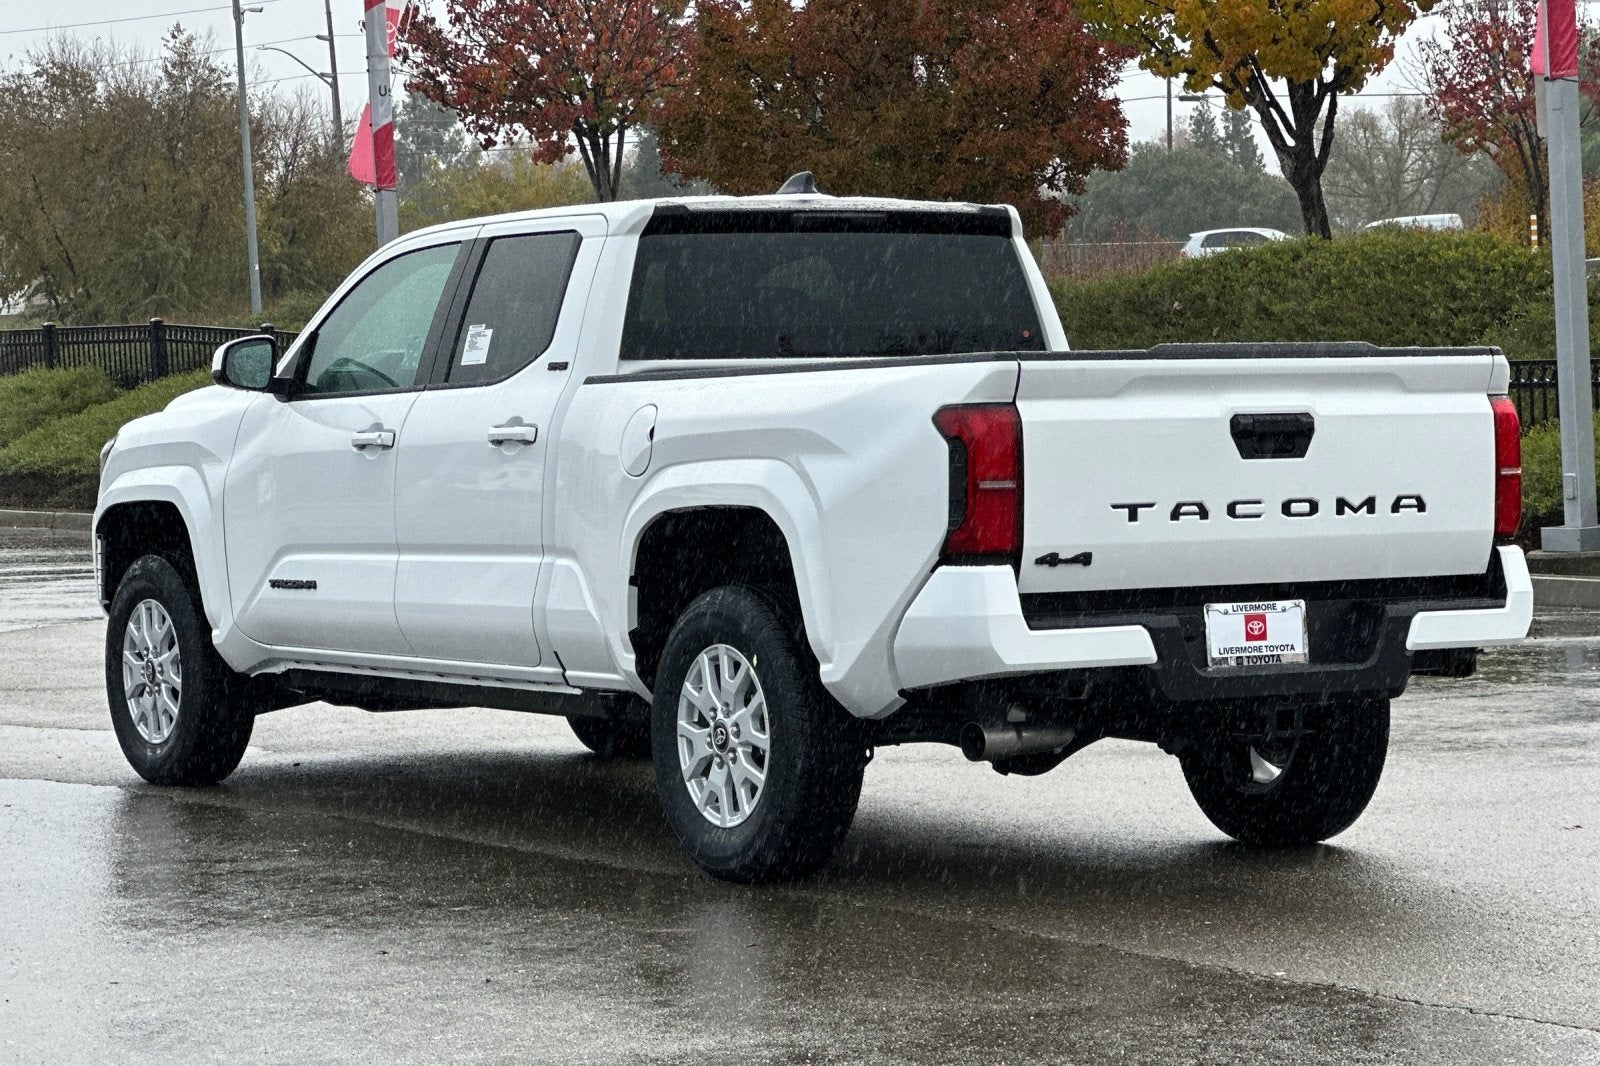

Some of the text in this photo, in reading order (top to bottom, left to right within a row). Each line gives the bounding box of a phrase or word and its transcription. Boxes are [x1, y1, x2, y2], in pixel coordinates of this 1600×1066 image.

[1110, 494, 1427, 523] TACOMA
[1231, 603, 1277, 613] LIVERMORE
[1218, 643, 1296, 656] LIVERMORE TOYOTA
[1245, 654, 1282, 665] TOYOTA
